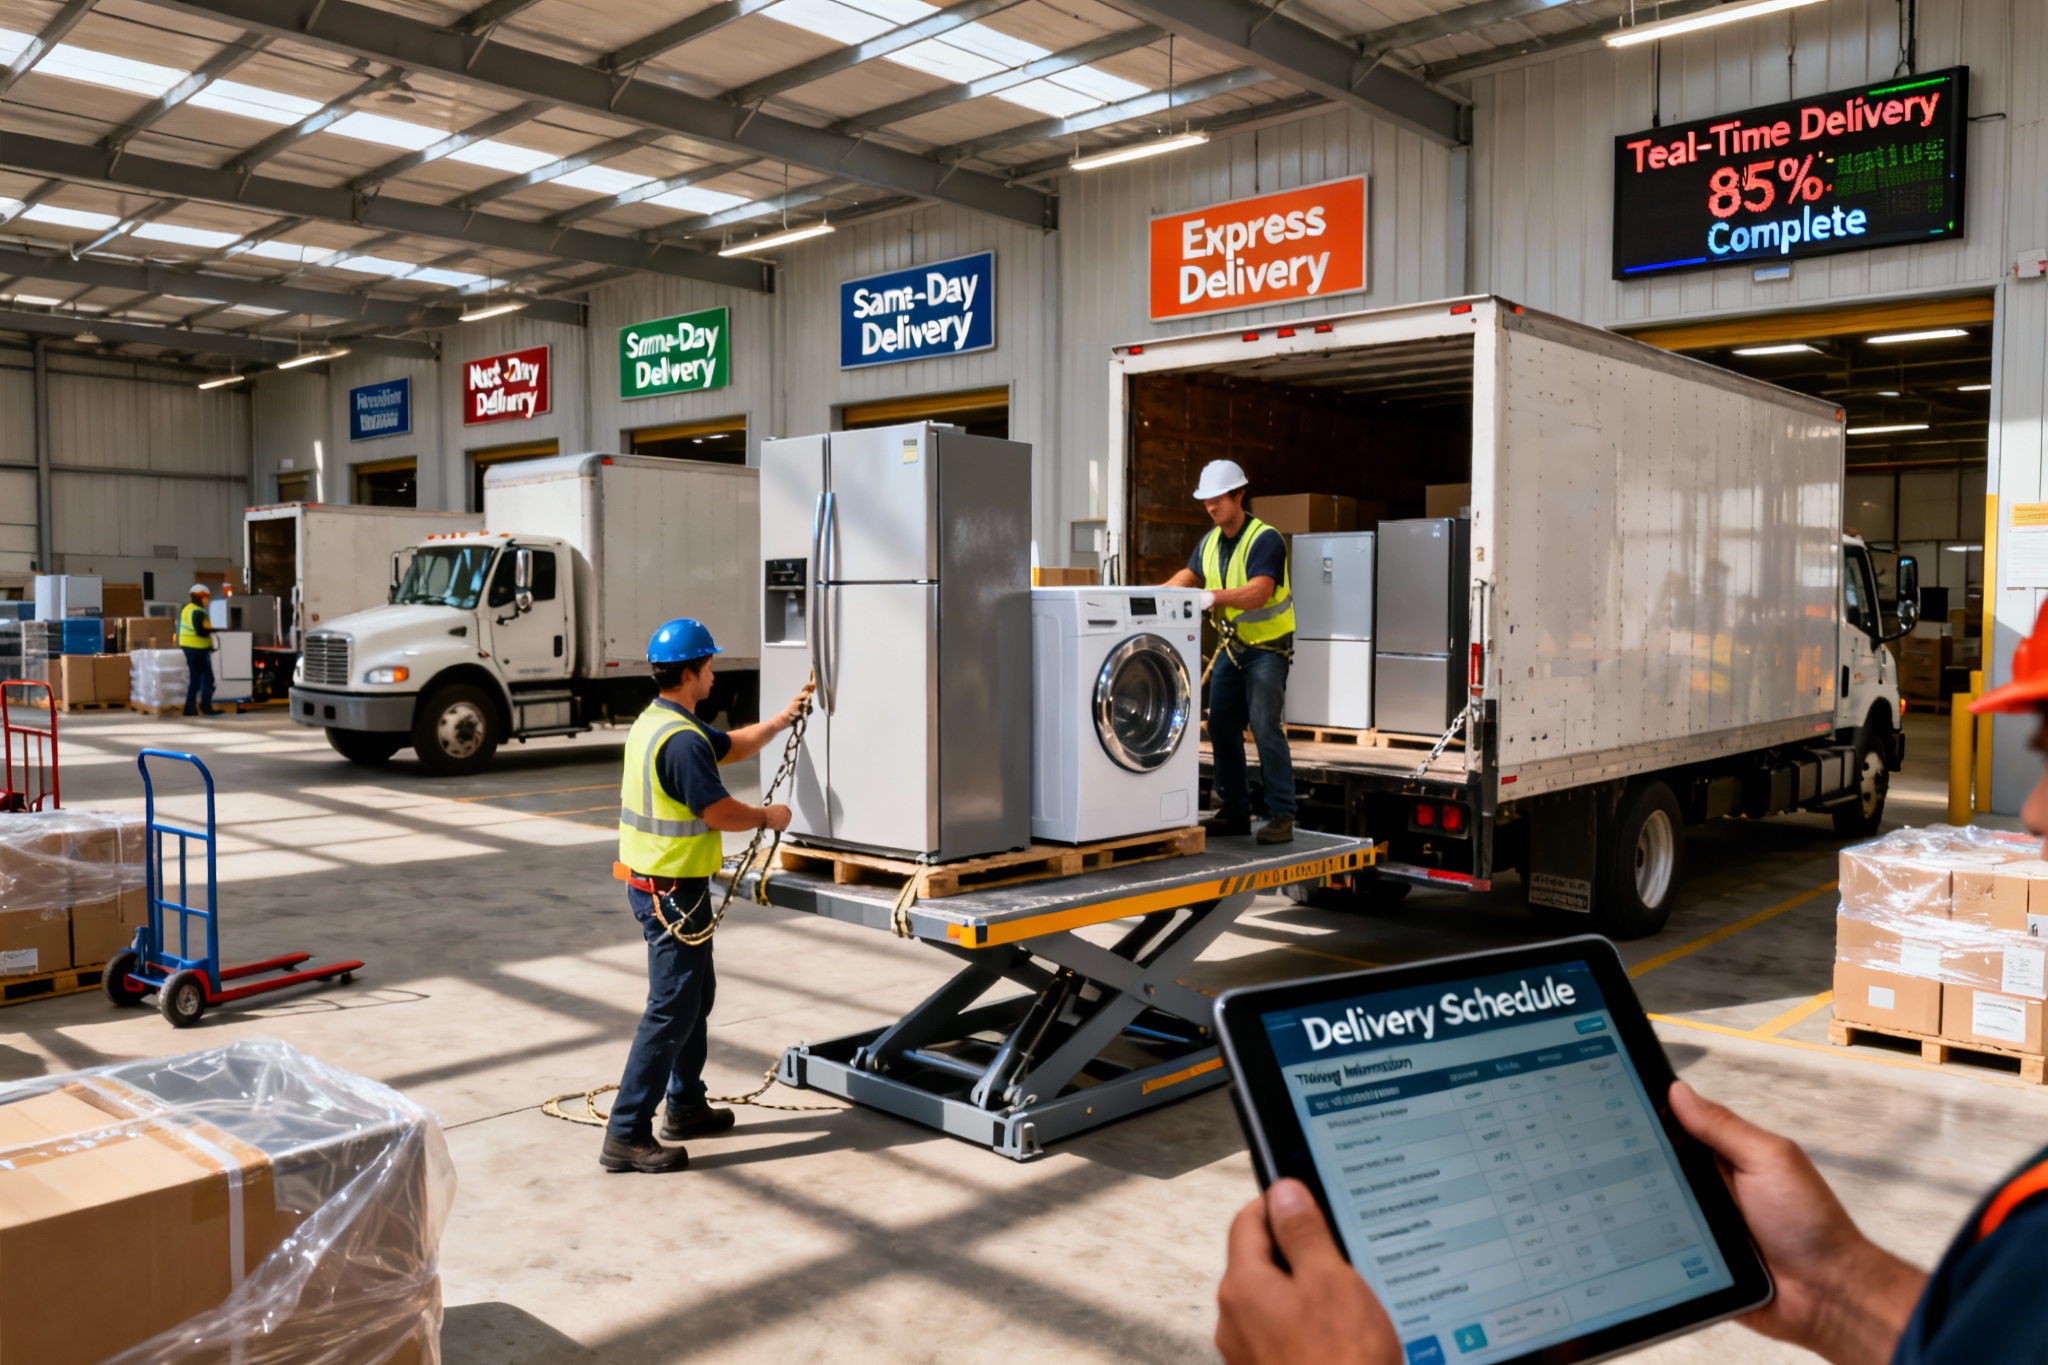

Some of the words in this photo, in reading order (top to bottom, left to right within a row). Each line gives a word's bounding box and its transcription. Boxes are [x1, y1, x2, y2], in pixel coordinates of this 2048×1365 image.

[1627, 120, 1790, 174] Teal-Time
[1800, 93, 1940, 141] Delivery
[1182, 206, 1327, 260] Express
[1707, 205, 1867, 254] Complete
[1180, 252, 1330, 305] Delivery
[861, 311, 973, 356] Delivery
[1302, 1005, 1435, 1050] Delivery
[1440, 976, 1576, 1026] Schedule
